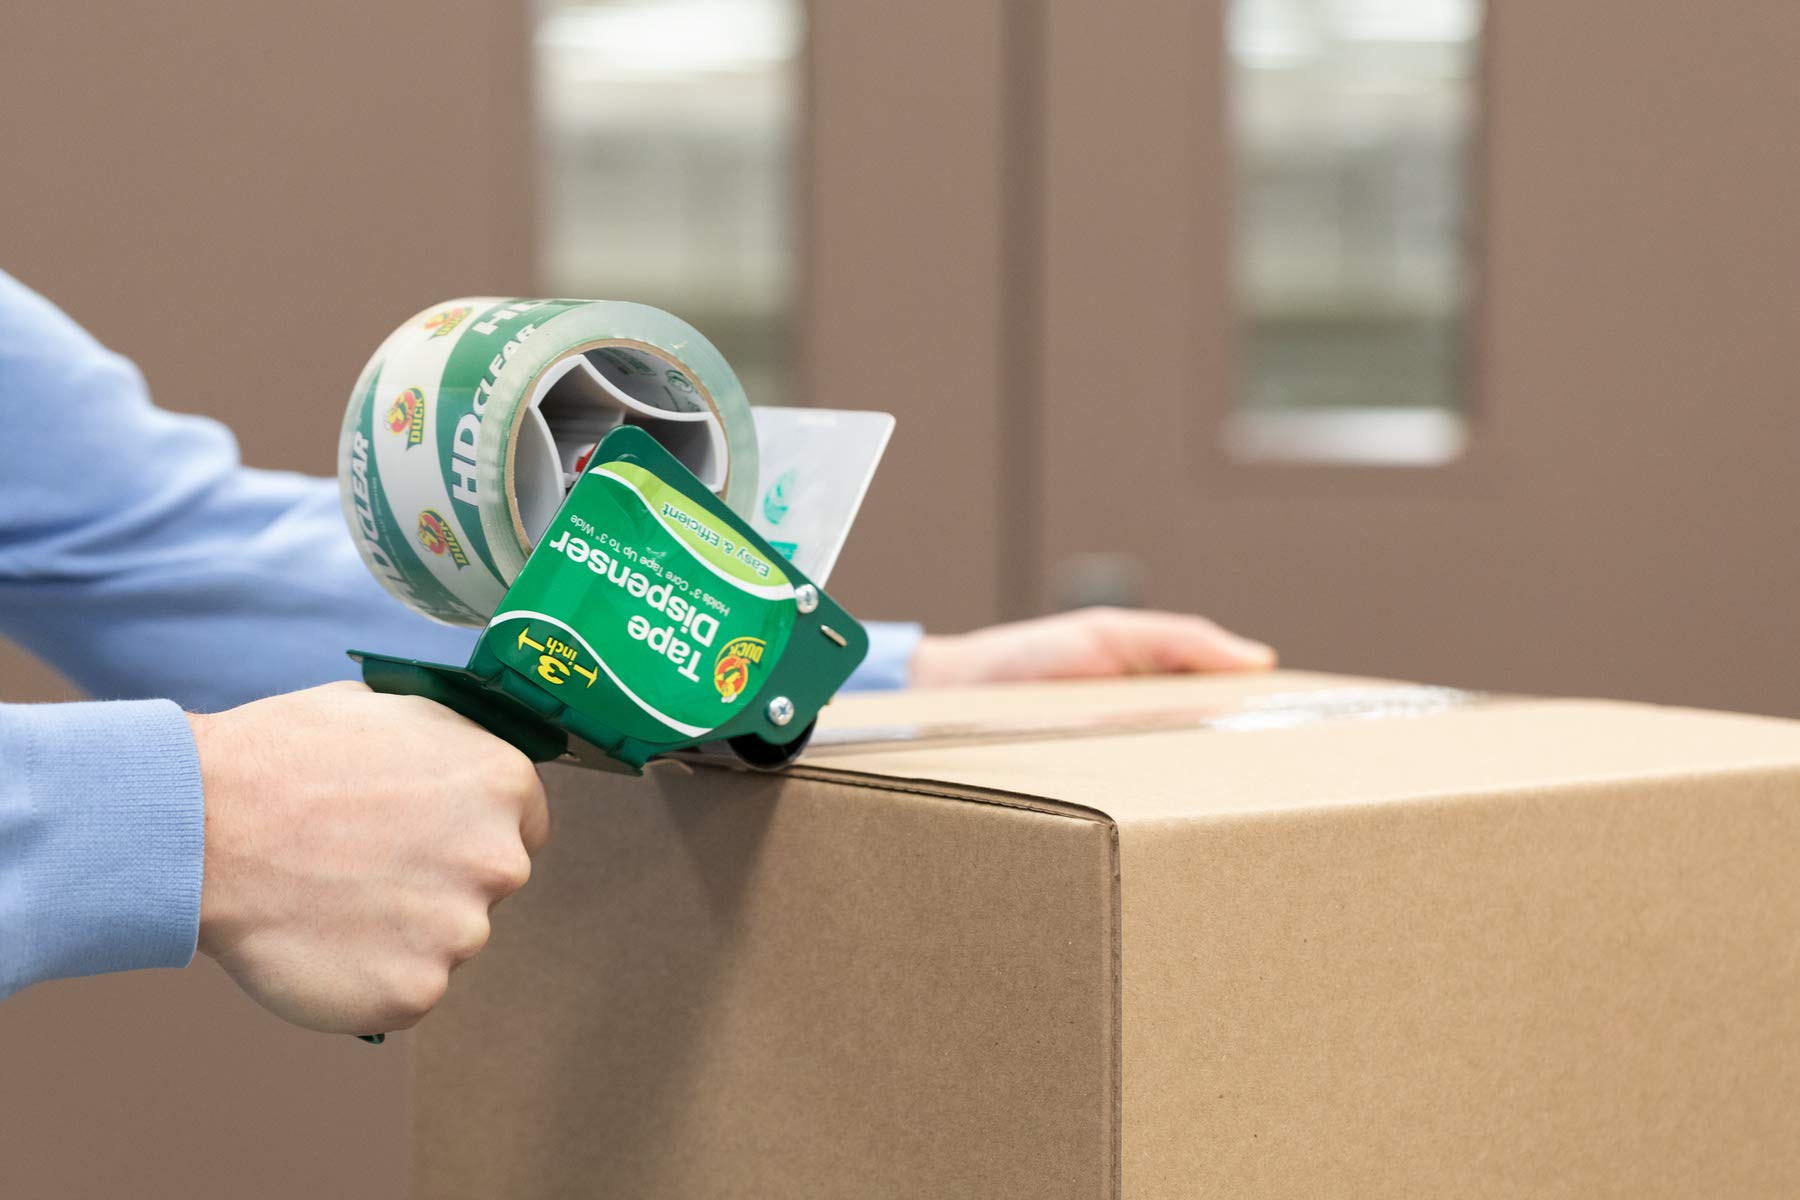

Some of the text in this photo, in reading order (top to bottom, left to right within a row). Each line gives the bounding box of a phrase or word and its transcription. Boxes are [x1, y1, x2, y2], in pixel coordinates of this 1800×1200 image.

[409, 399, 423, 444] DUCK
[452, 413, 480, 507] HD
[570, 514, 596, 537] Wide
[608, 538, 622, 553] To
[661, 502, 771, 578] Easy & Efficient
[623, 546, 638, 562] Up
[639, 556, 665, 578] Tape
[549, 531, 721, 648] Dispenser
[665, 571, 690, 592] Core
[702, 592, 731, 617] Holds
[546, 637, 578, 666] inch
[627, 613, 703, 683] Tape
[728, 641, 764, 664] DUCK
[537, 655, 571, 685] 3
